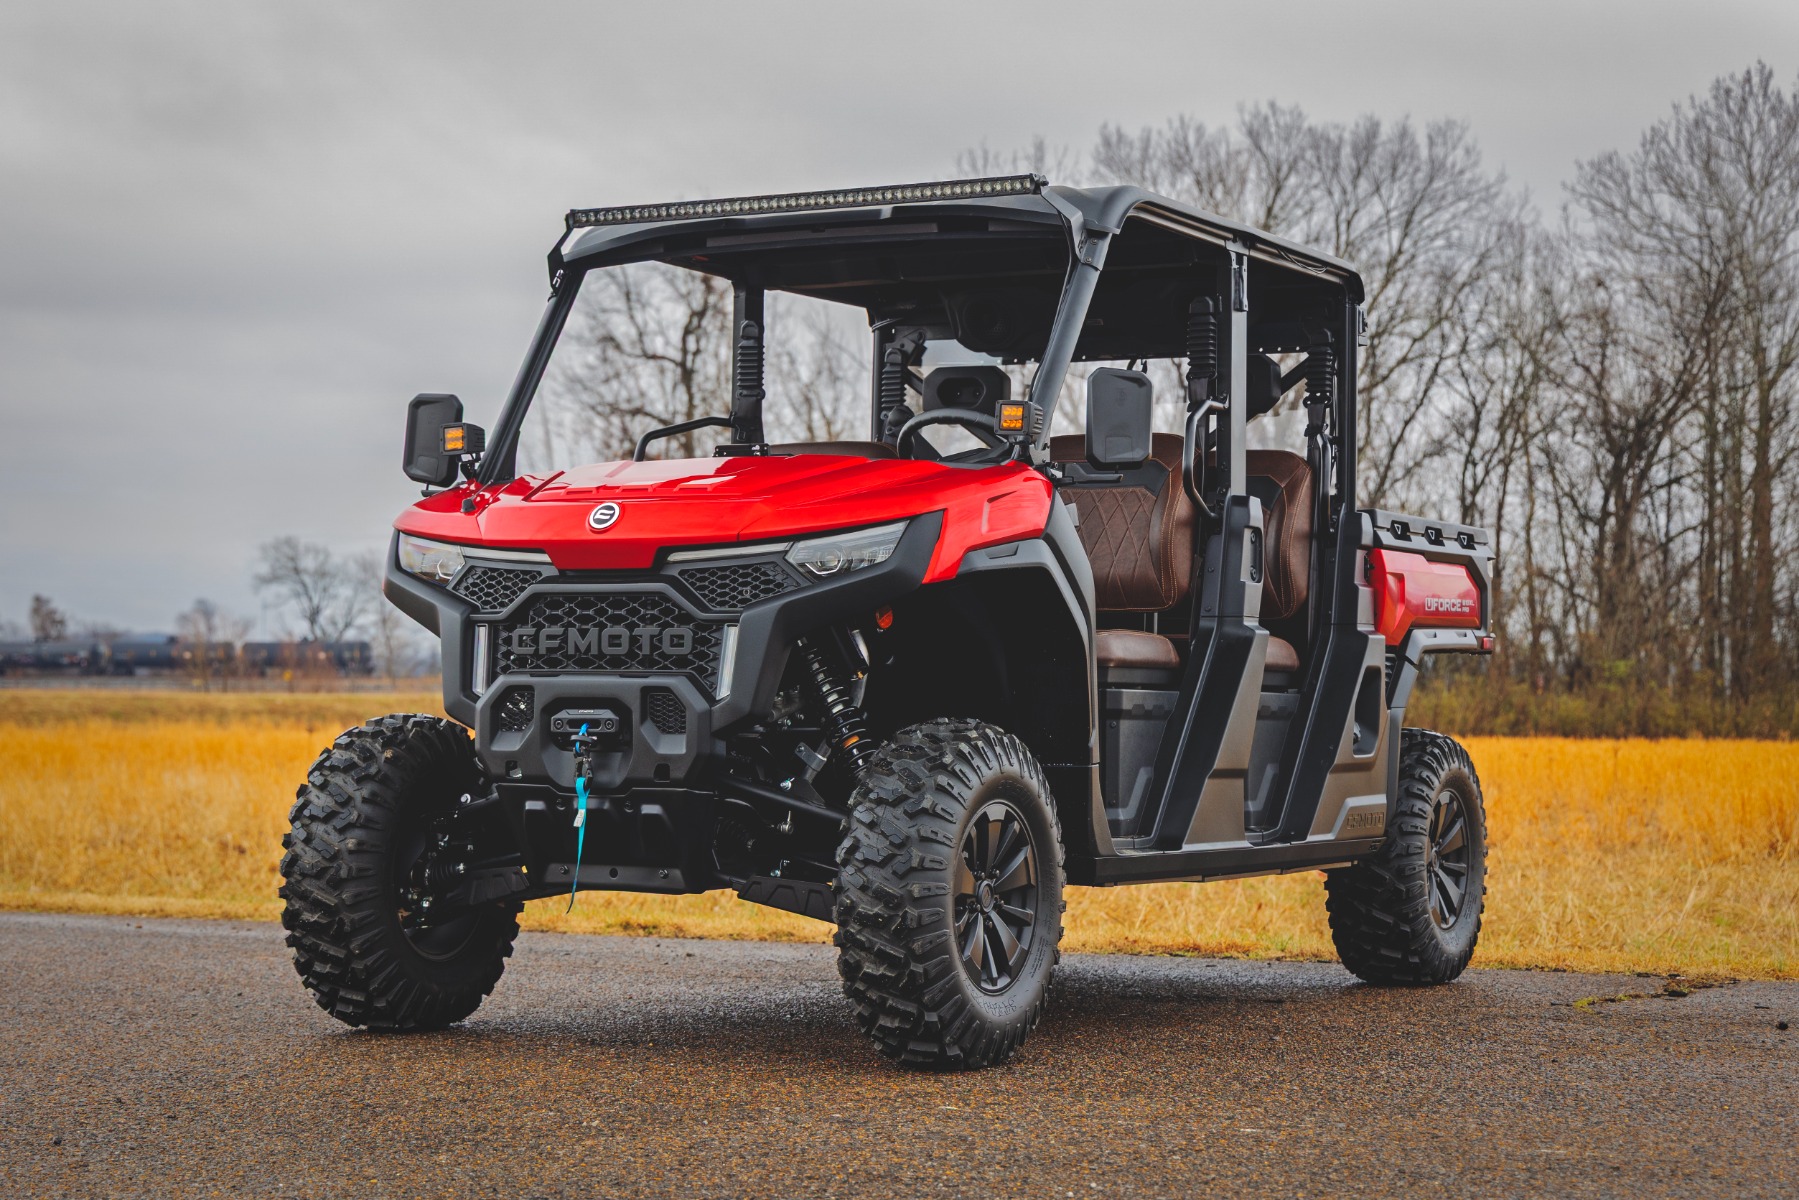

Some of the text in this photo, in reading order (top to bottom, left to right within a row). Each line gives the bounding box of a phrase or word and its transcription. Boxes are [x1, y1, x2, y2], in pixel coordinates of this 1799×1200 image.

[1425, 597, 1461, 612] UFORCE
[511, 628, 693, 655] CFMOTO
[1346, 811, 1385, 830] CFMOTO
